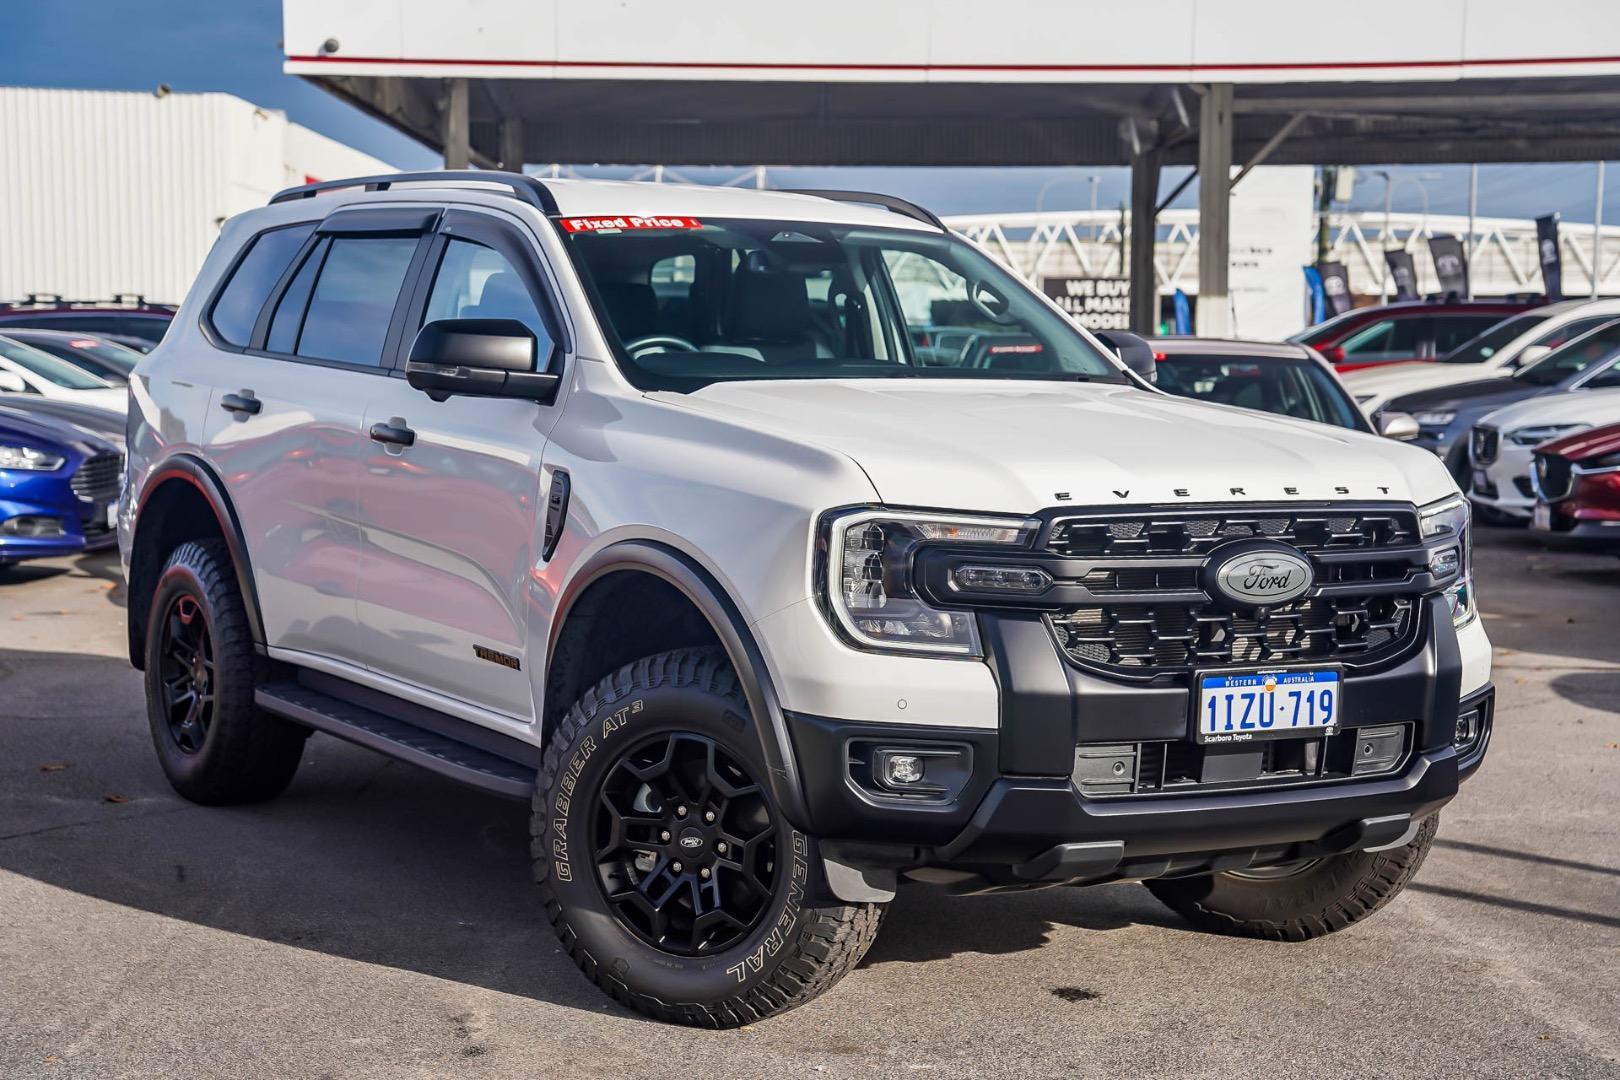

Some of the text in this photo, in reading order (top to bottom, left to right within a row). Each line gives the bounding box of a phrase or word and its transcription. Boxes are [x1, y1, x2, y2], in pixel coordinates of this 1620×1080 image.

[569, 217, 685, 230] Fixed Price
[1065, 280, 1130, 296] WE BUY
[1054, 487, 1390, 500] EVEREST
[1243, 564, 1292, 590] Ford
[1225, 676, 1315, 687] WESTERN AUSTRALIA
[1204, 733, 1253, 743] Scarboro Toyota
[553, 735, 597, 882] GRABBER
[726, 829, 808, 983] GENERAL
